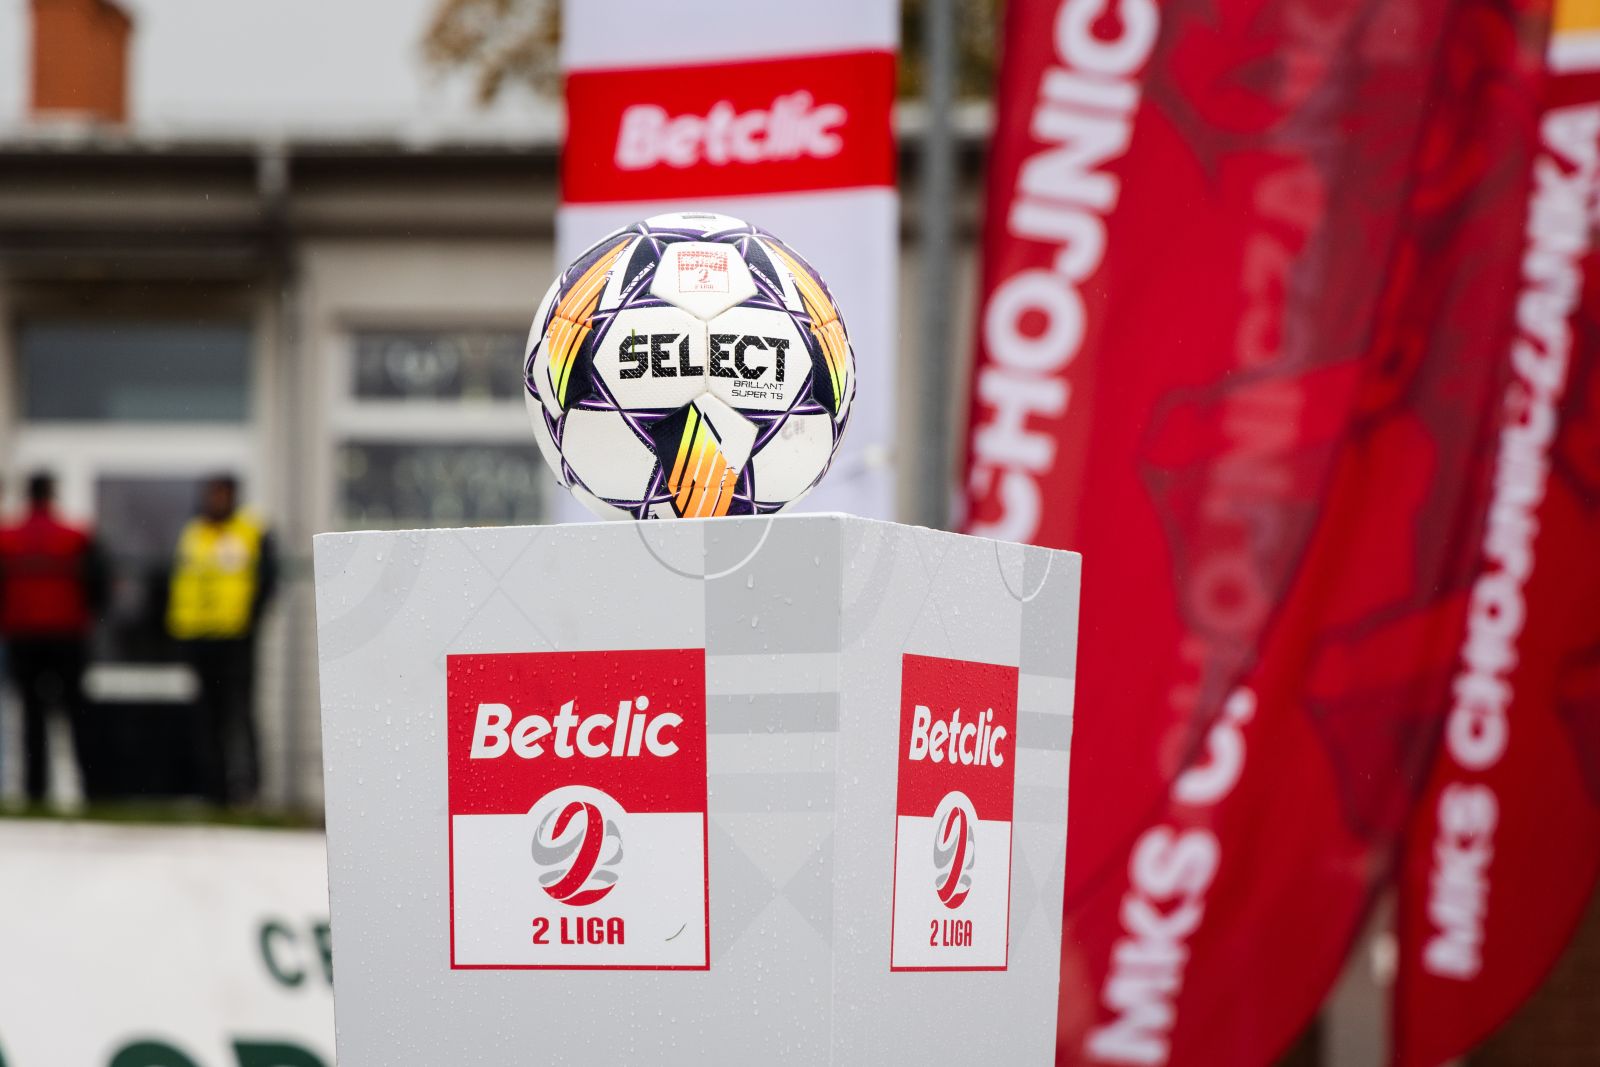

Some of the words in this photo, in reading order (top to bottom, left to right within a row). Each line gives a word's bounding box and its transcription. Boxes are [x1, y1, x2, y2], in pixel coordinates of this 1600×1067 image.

[613, 90, 848, 171] Betclic
[619, 333, 790, 382] SELECT
[733, 380, 784, 390] BRILLANT
[731, 389, 767, 399] SUPER
[470, 695, 684, 759] Betclic
[909, 705, 1007, 767] Betclic
[1422, 781, 1500, 981] MKS
[532, 916, 550, 945] 2
[560, 916, 625, 945] LIGA
[930, 921, 938, 946] 2
[942, 920, 972, 947] LIGA
[1087, 825, 1222, 1066] MKS
